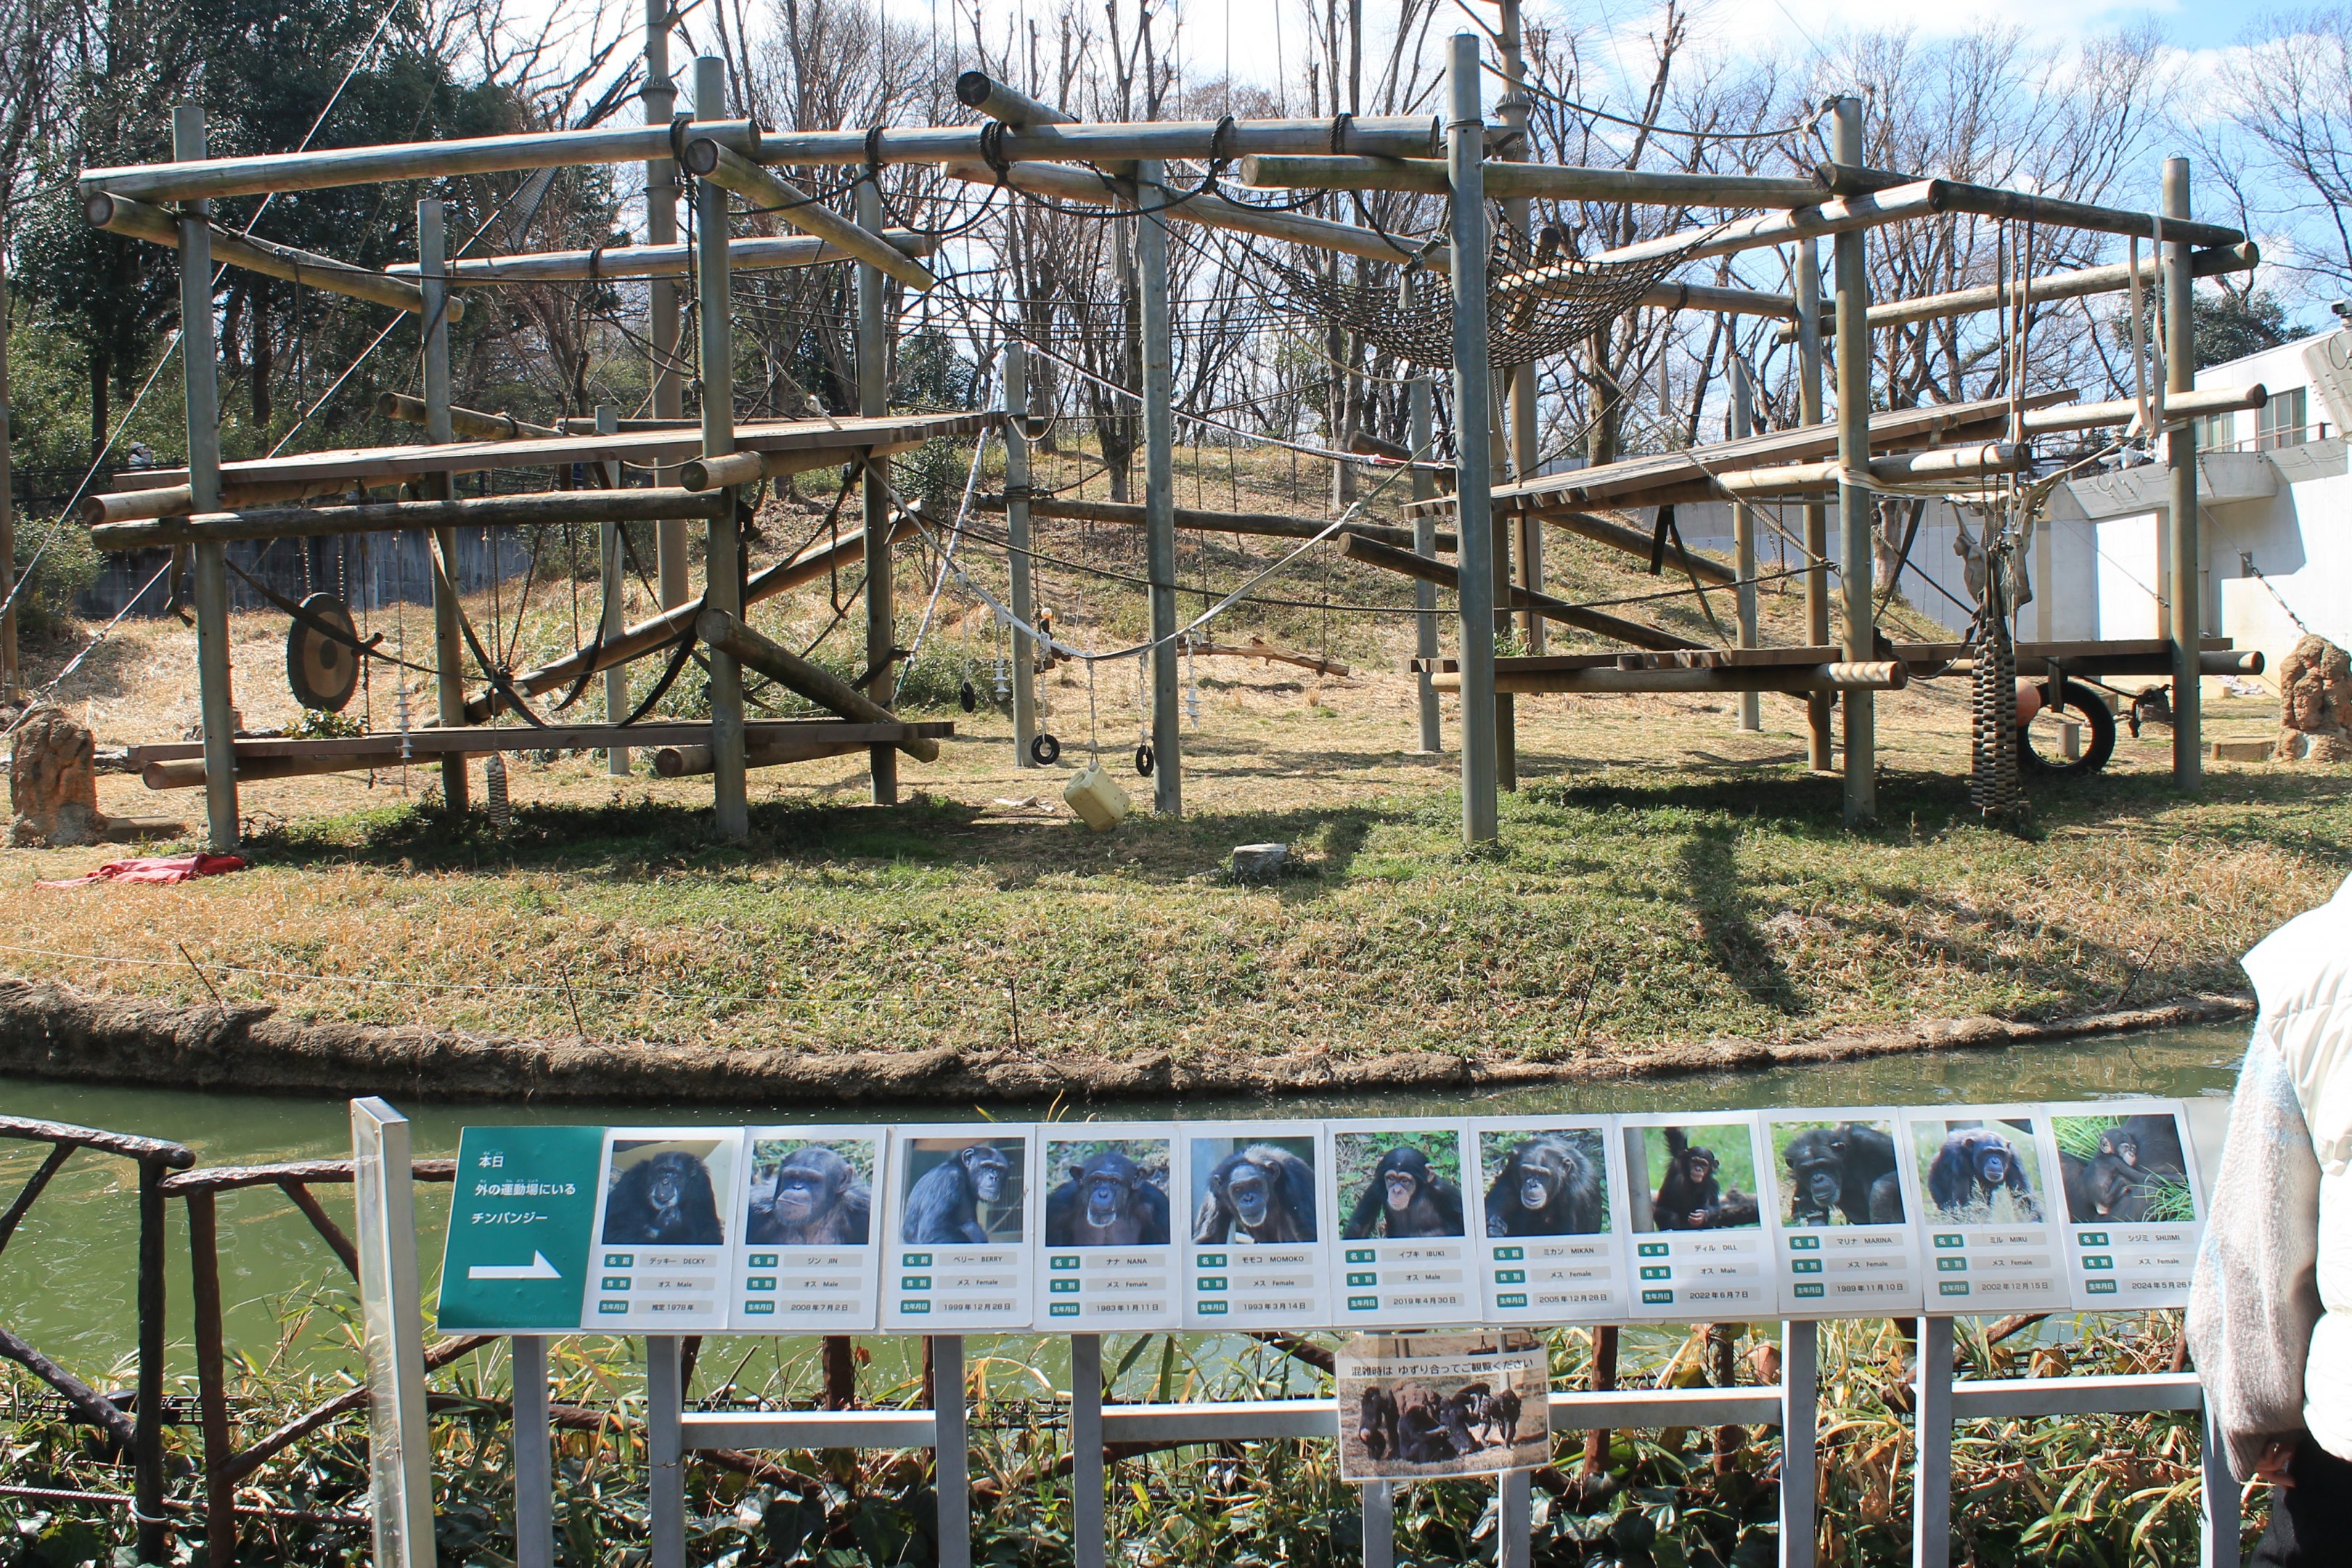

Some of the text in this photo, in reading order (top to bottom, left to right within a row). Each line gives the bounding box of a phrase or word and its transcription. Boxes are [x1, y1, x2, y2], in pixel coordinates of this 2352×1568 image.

[478, 1156, 504, 1167] 本日
[475, 1183, 576, 1196] 外の運動場にいる
[1352, 1359, 1533, 1376] 混雑時は ゆずり合ってご観覧ください
